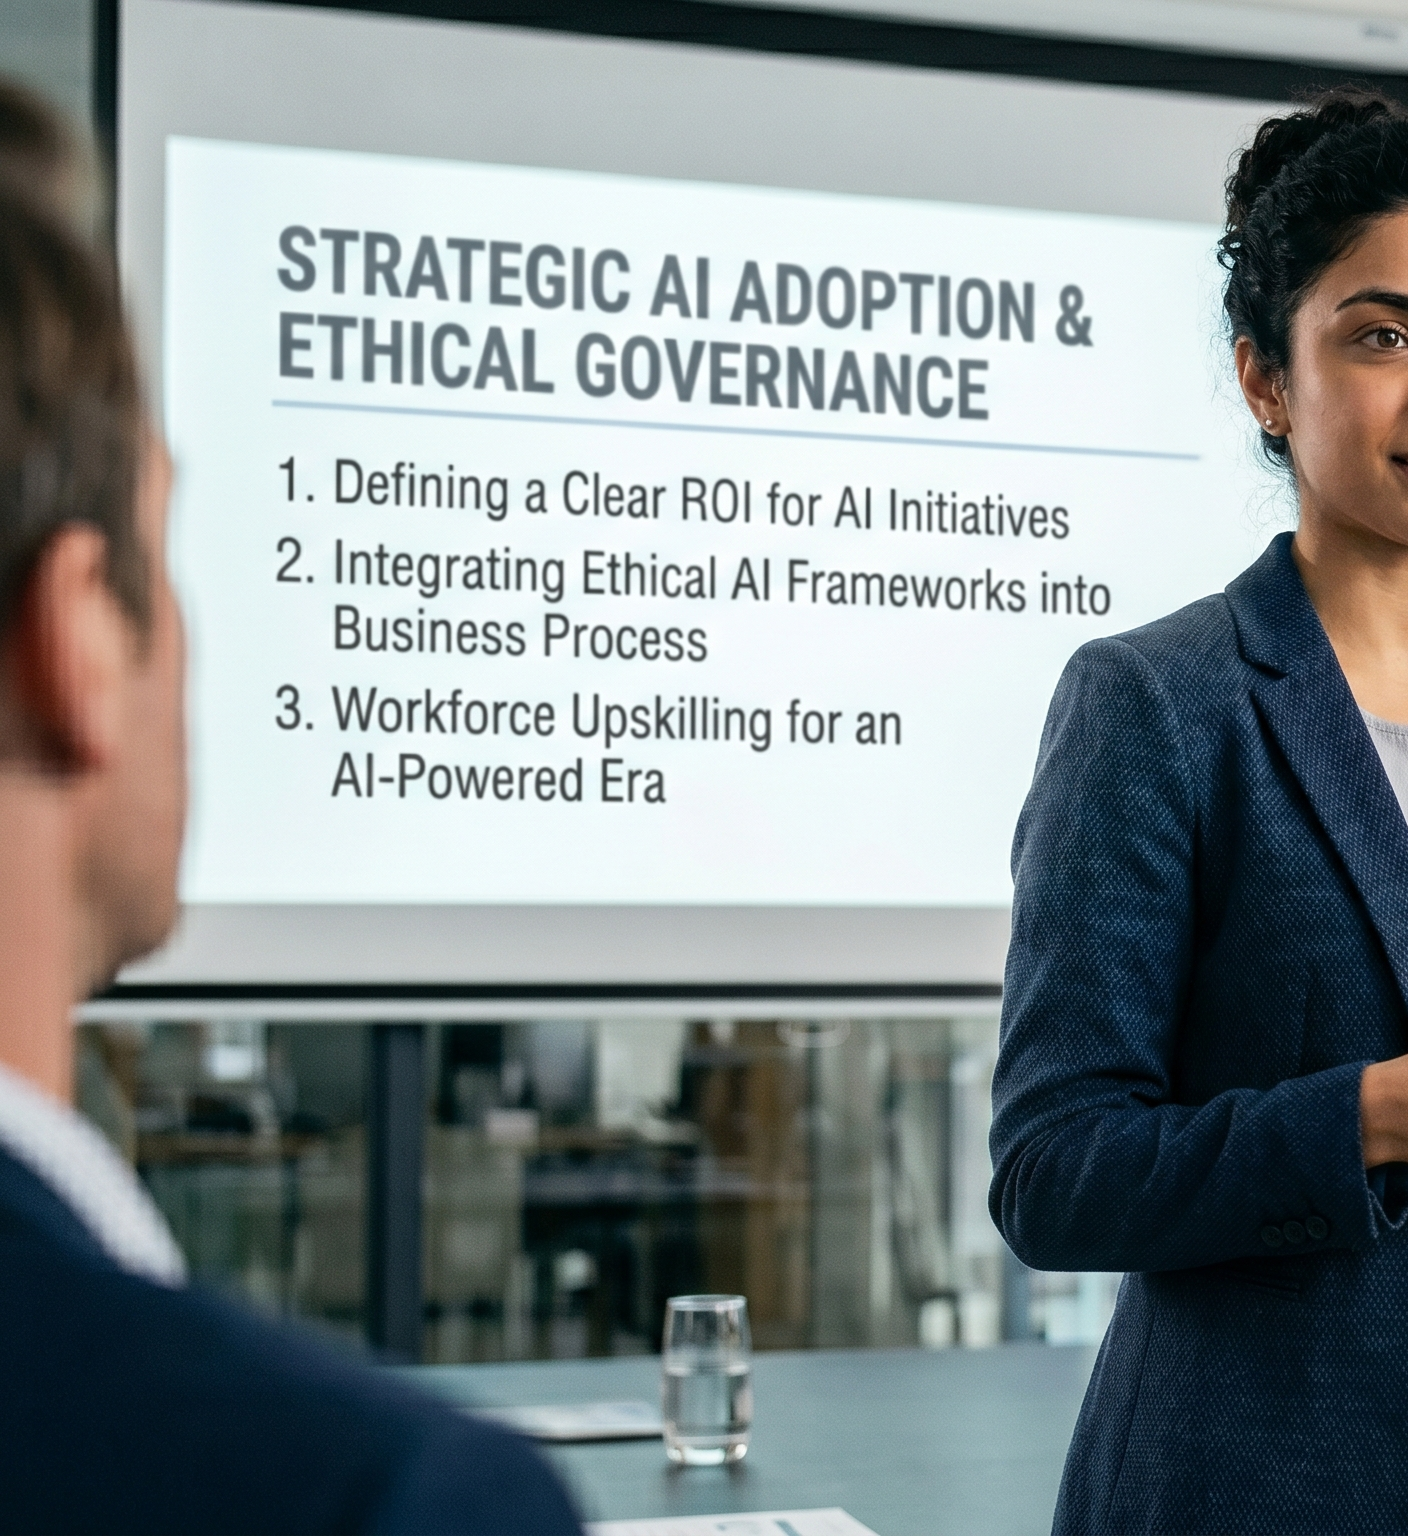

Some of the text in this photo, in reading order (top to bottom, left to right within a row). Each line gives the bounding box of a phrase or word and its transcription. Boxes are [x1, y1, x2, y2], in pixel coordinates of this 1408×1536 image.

[277, 225, 1093, 347] STRATEGIC AI ADOPTION &
[279, 311, 989, 421] ETHICAL GOVERNANCE
[278, 456, 1070, 540] 1. Defining a Clear ROI for AI Initiatives
[276, 536, 1111, 616] 2. Integrating Ethical AI Frameworks into
[334, 604, 708, 663] Business Process
[275, 683, 901, 753] 3. Workforce Upskilling for an
[331, 751, 667, 804] AI-Powered Era
